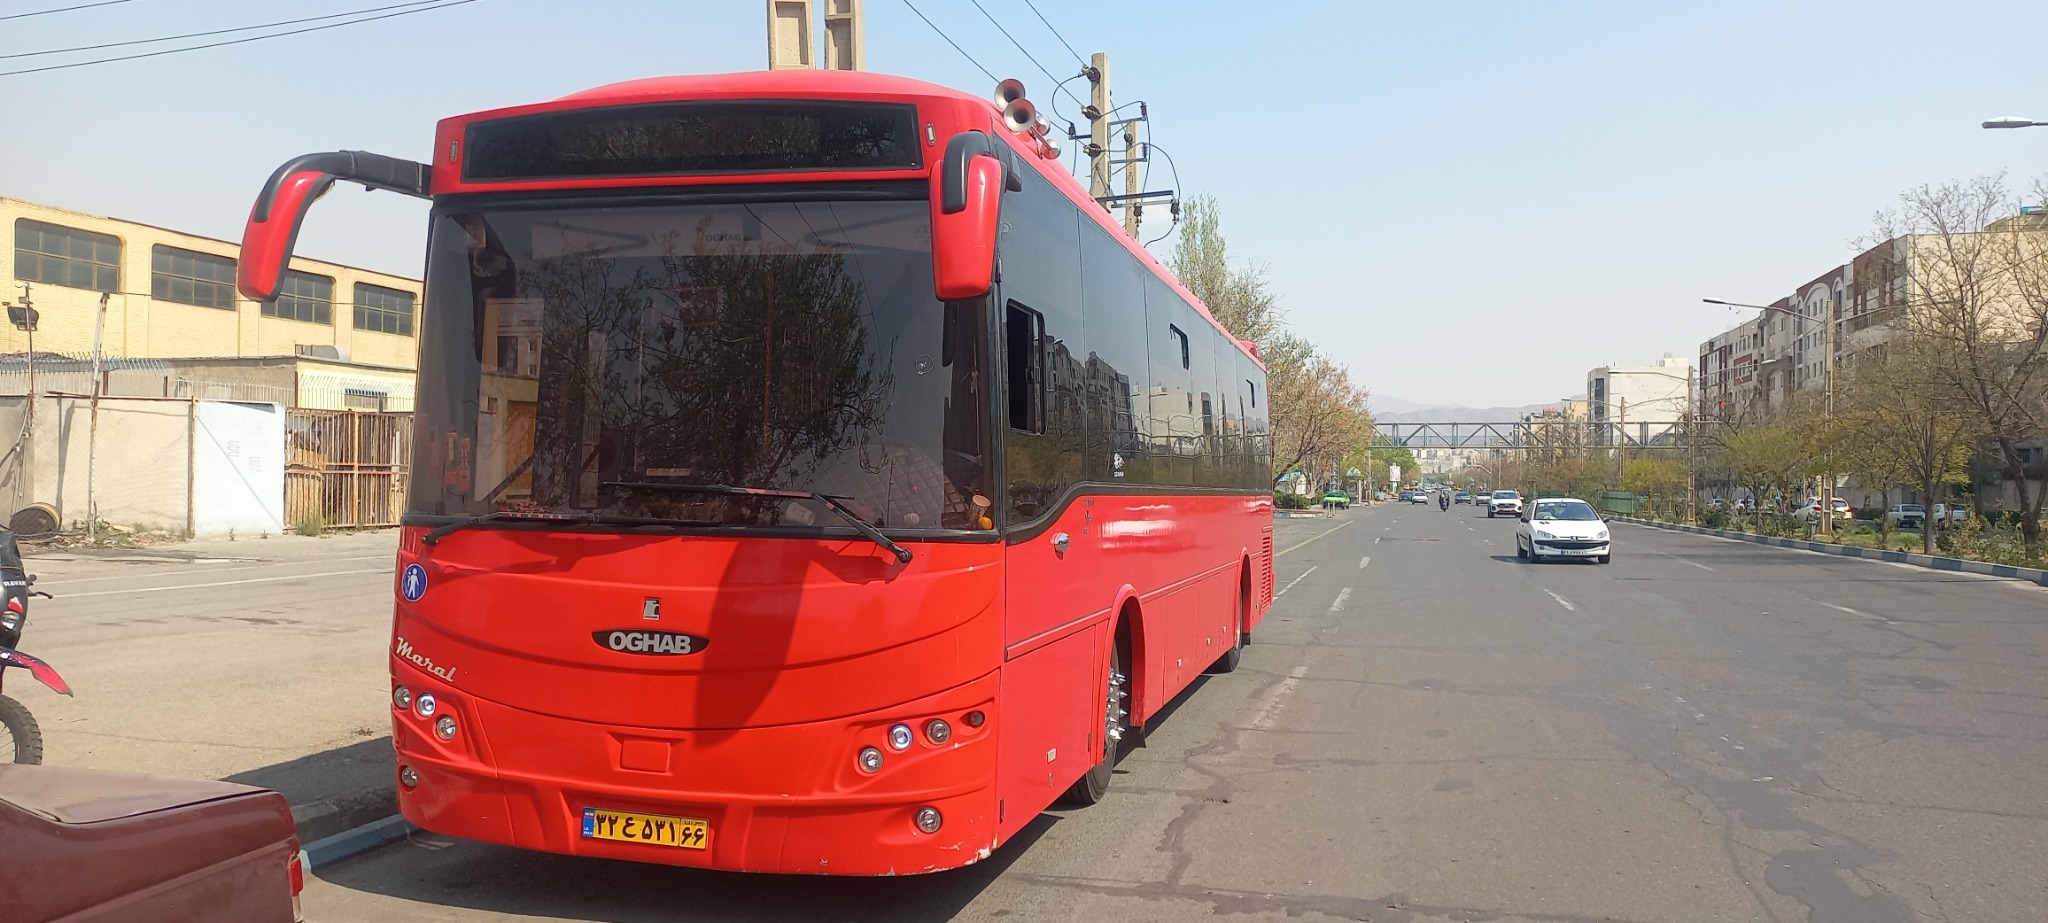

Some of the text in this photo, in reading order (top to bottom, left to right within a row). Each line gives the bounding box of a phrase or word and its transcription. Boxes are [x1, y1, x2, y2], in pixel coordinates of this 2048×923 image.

[609, 631, 691, 654] OGHAB
[396, 637, 457, 682] Maral
[596, 814, 618, 836] ۳۲
[641, 818, 675, 843] ۵۳۱
[681, 827, 704, 846] ۶۶
